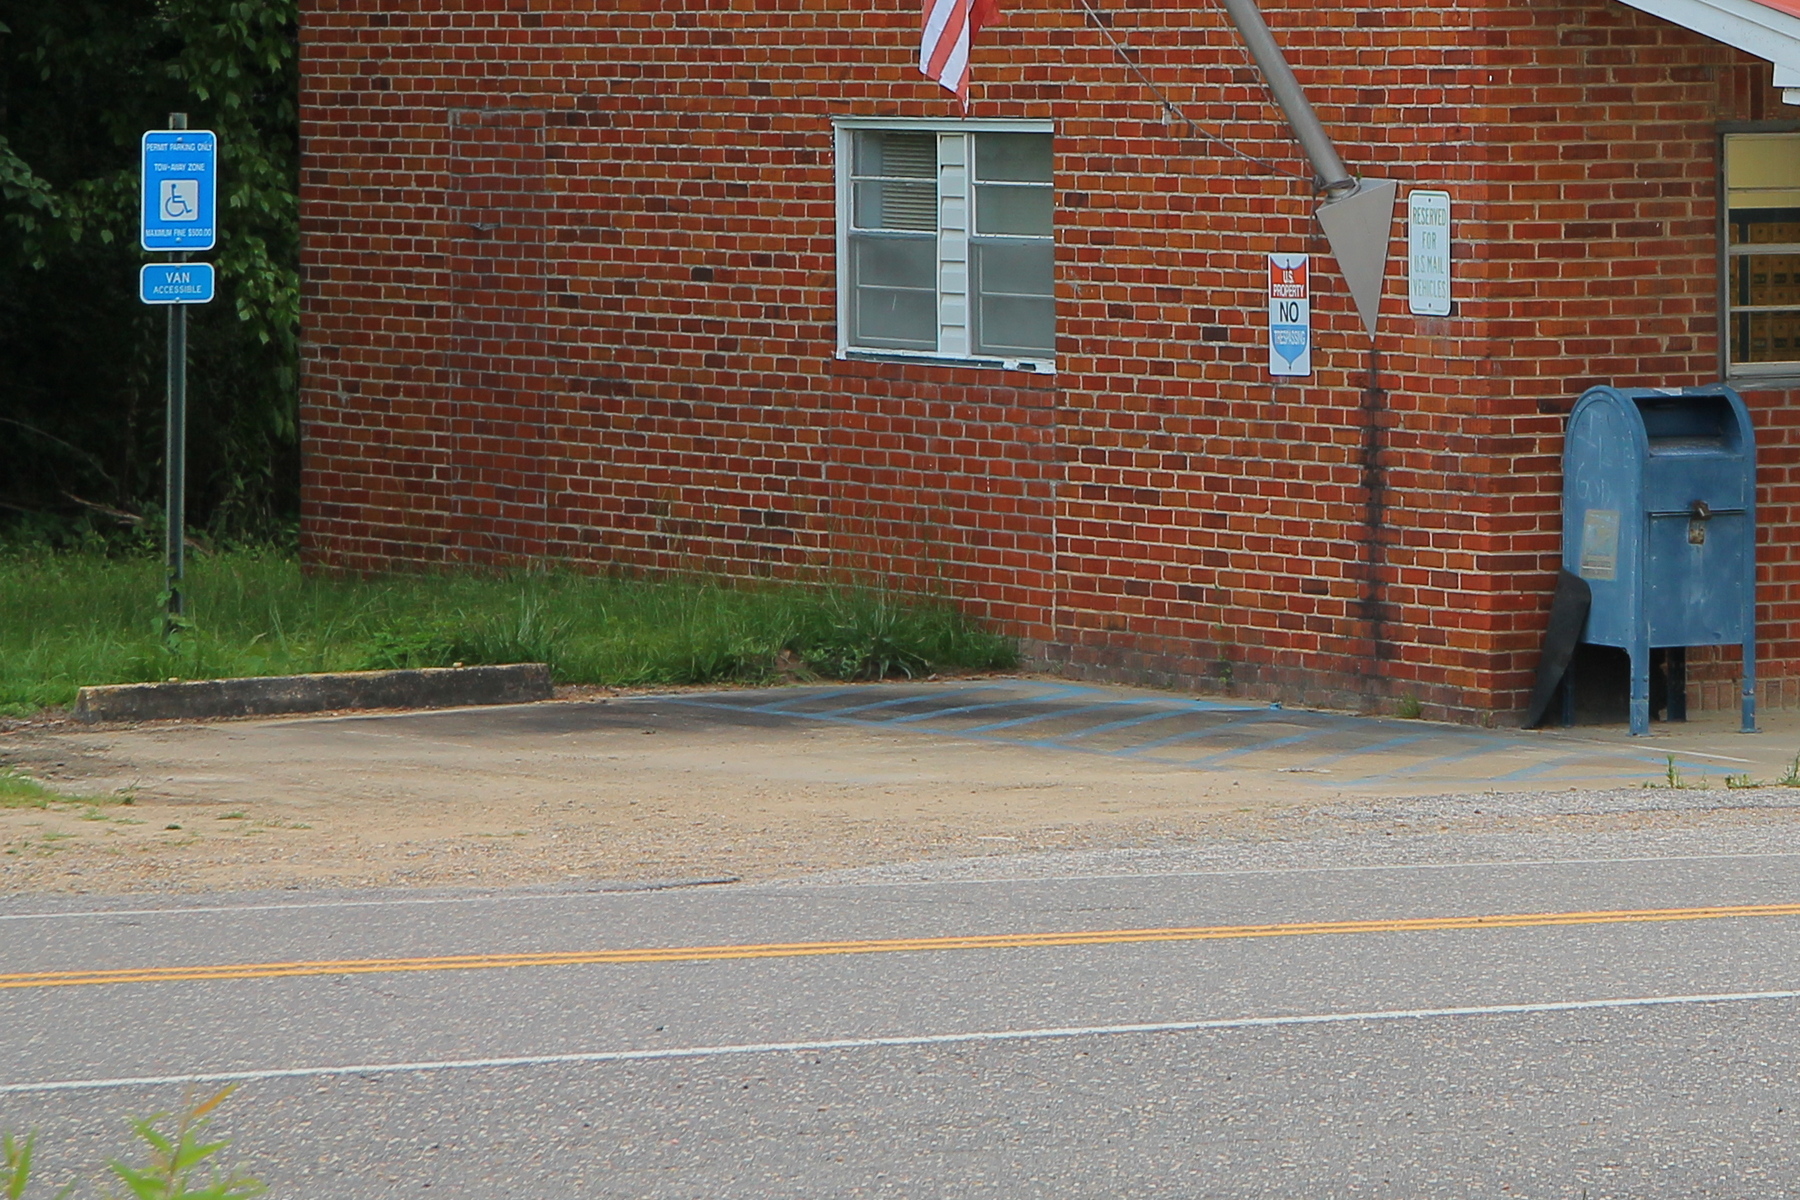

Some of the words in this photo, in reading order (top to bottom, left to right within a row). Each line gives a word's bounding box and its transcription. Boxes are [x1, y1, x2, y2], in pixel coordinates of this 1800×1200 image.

[170, 143, 196, 151] PARKING
[197, 143, 212, 151] ONLY
[187, 163, 206, 171] ZONE
[1412, 207, 1446, 226] RESERVED
[173, 229, 187, 237] FINE
[1422, 231, 1437, 250] FOR
[1427, 256, 1444, 274] MAIL
[165, 272, 191, 284] VAN
[152, 285, 203, 294] ACCESSIBLE
[1273, 284, 1305, 297] PROPERTY
[1412, 279, 1446, 299] VEHICLES
[1279, 301, 1299, 323] NO
[1273, 329, 1306, 345] TRESPASSING
